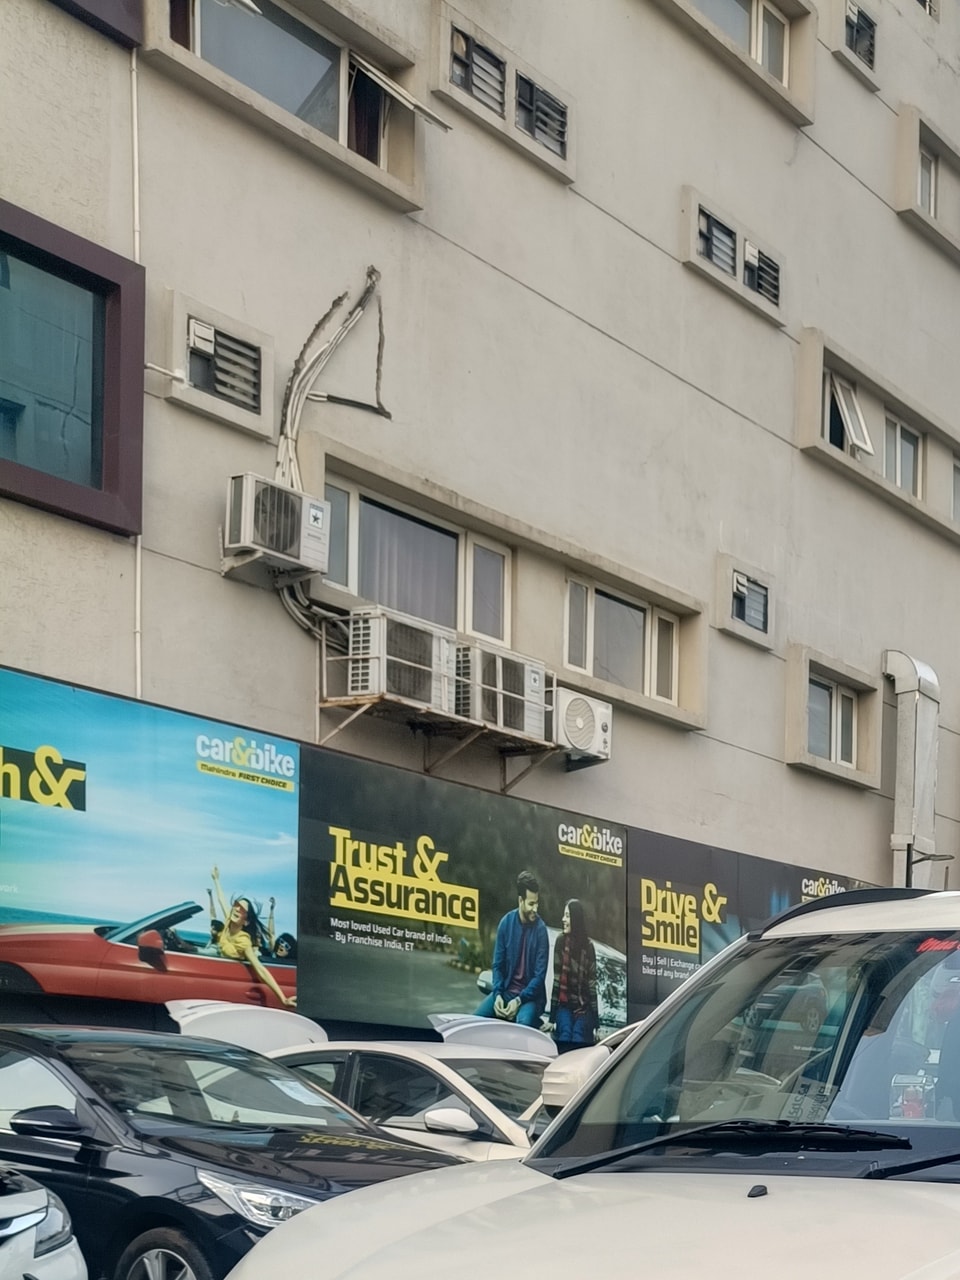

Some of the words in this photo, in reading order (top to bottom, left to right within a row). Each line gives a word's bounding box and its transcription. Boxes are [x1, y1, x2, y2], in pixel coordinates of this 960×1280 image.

[196, 735, 295, 777] car&bike
[28, 745, 86, 810] &
[200, 763, 237, 778] Mahindra
[238, 772, 260, 783] FIRST
[260, 777, 288, 788] CHOICE
[328, 826, 408, 876] Trust
[413, 835, 449, 883] &
[558, 823, 623, 855] car&bike
[331, 864, 476, 922] Assurance
[641, 878, 697, 918] Drive
[702, 883, 727, 923] &
[330, 917, 349, 929] Most
[351, 921, 371, 933] loved
[372, 924, 391, 936] Used
[392, 926, 404, 937] Car
[405, 928, 425, 941] brand
[427, 932, 435, 942] of
[435, 934, 452, 945] India
[335, 931, 346, 944] By
[347, 934, 383, 948] Franchise
[384, 939, 404, 951] India,
[404, 942, 414, 951] ET
[642, 910, 698, 948] Smile
[642, 954, 653, 966] Buy
[657, 957, 667, 966] Sell
[670, 958, 695, 971] Exchange
[642, 965, 656, 976] bikes
[657, 967, 664, 976] of
[663, 969, 674, 980] any
